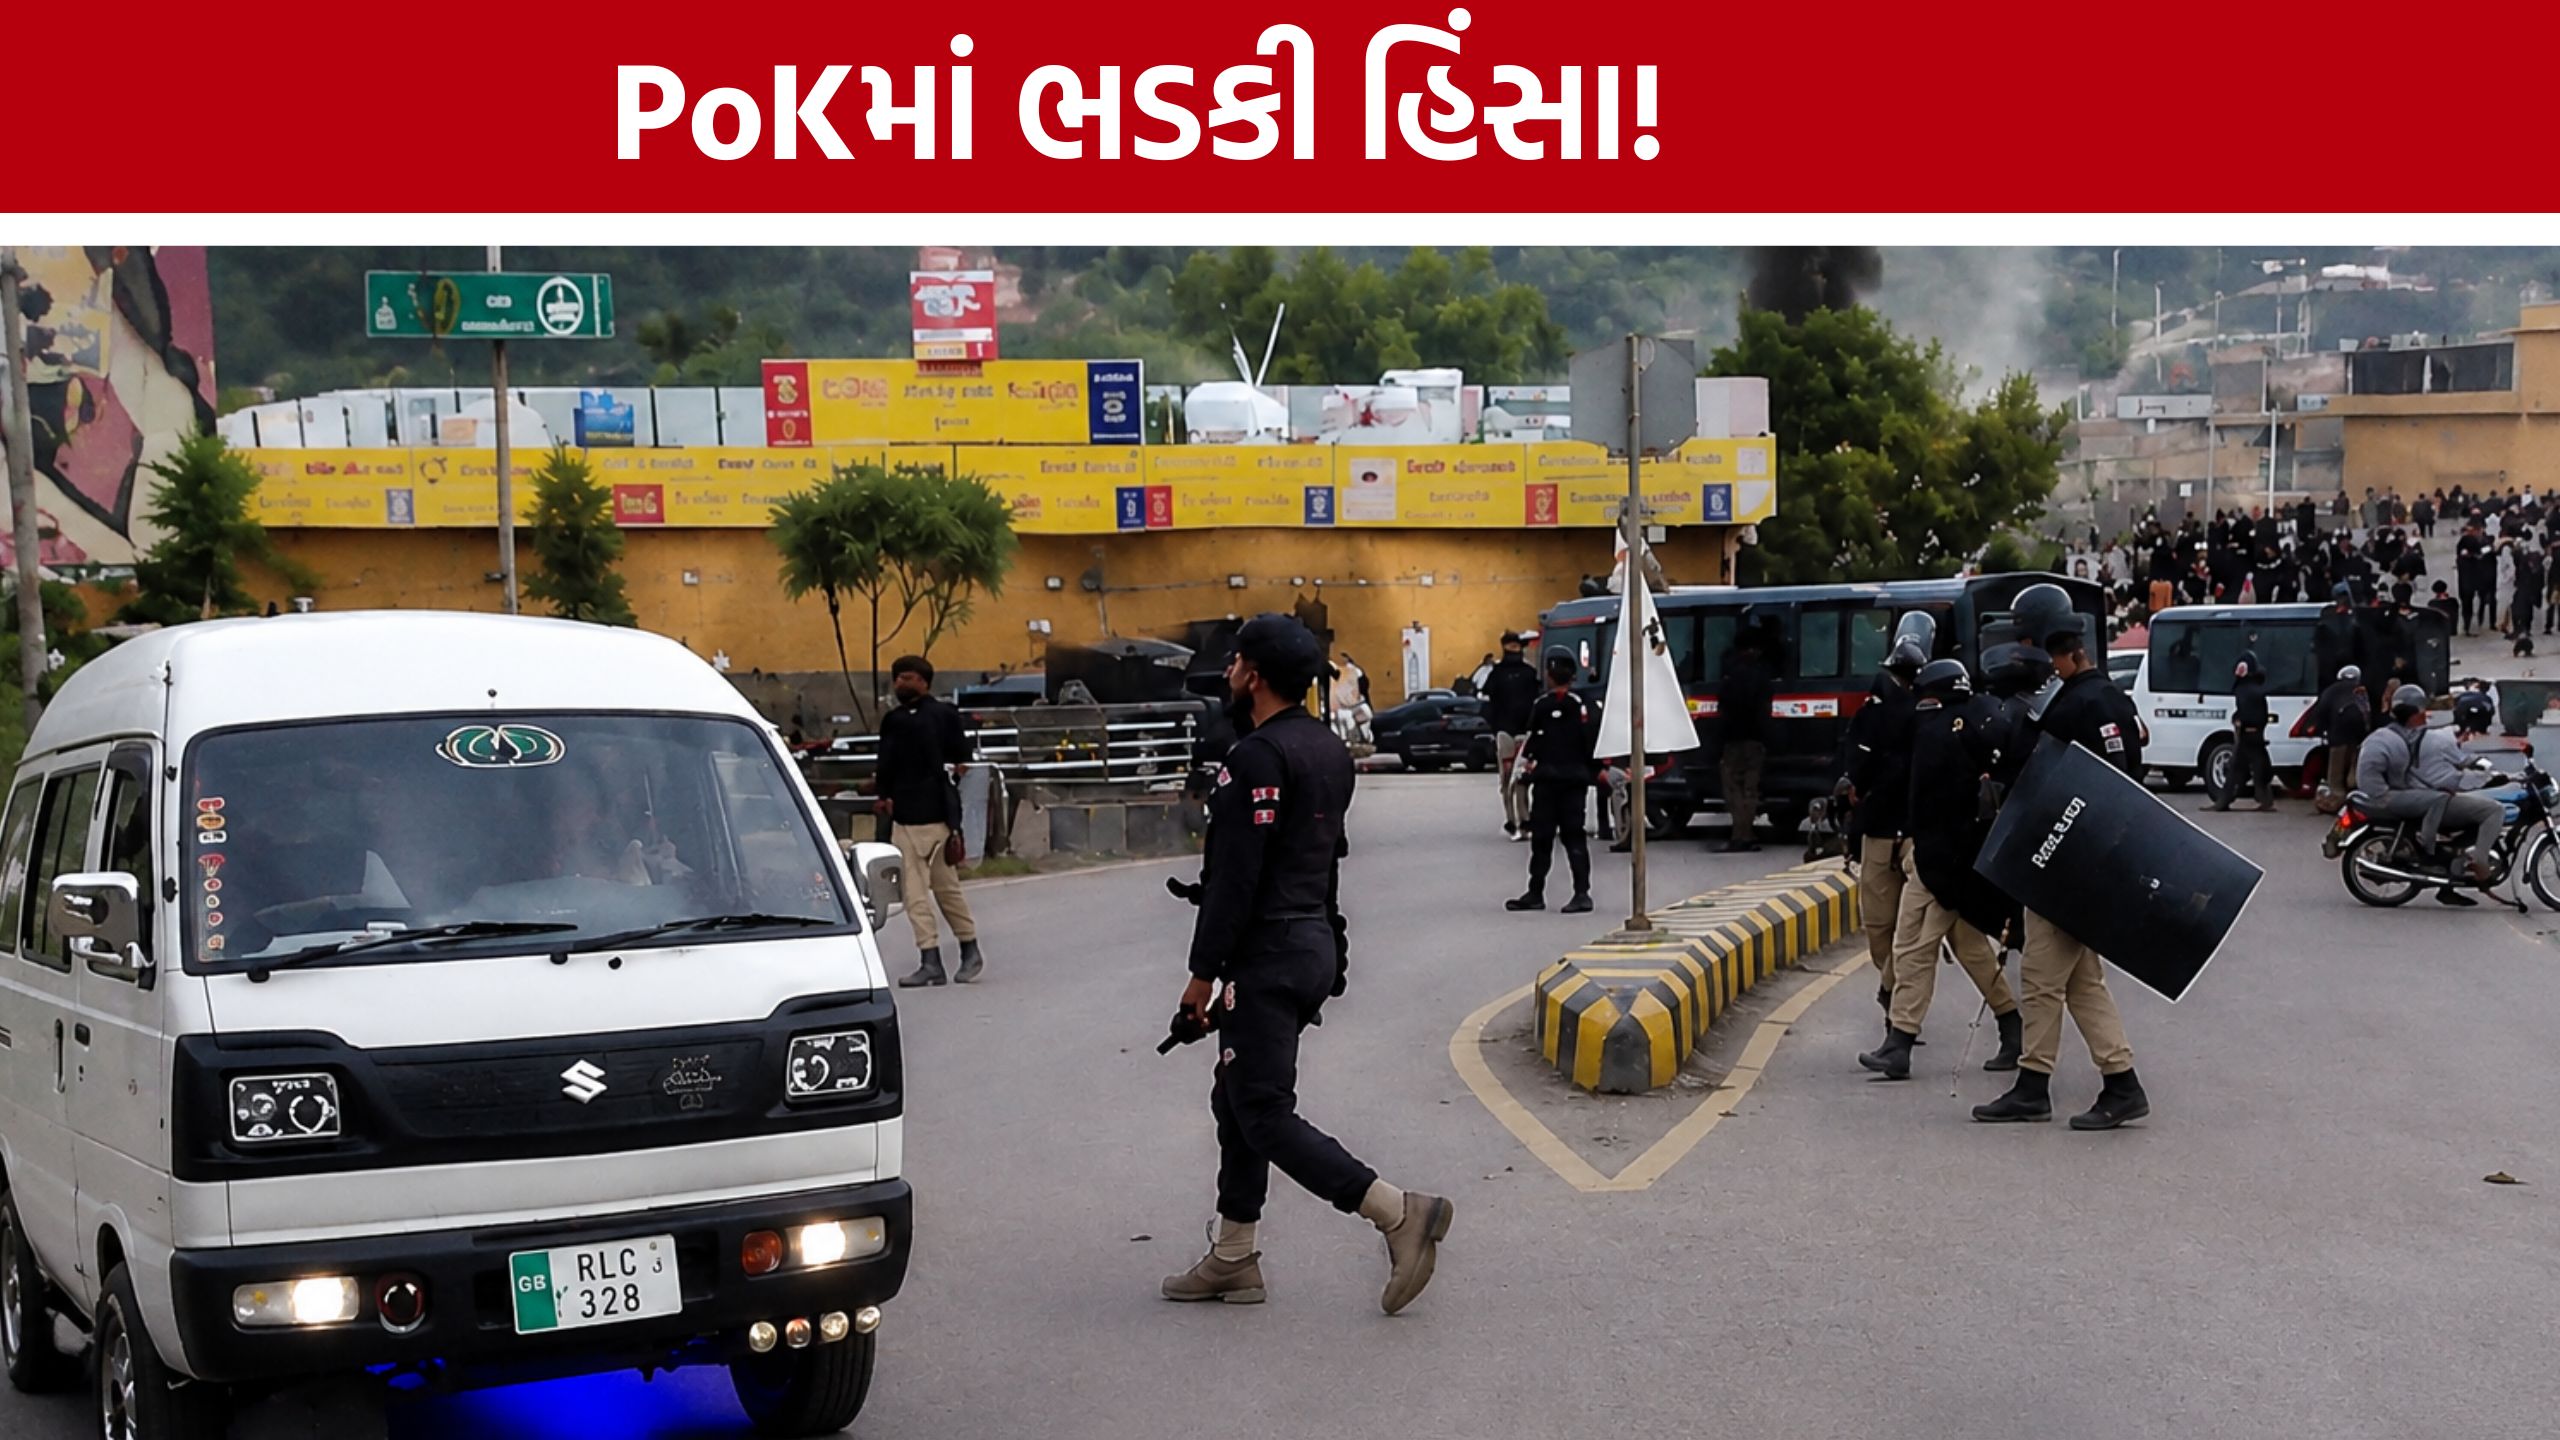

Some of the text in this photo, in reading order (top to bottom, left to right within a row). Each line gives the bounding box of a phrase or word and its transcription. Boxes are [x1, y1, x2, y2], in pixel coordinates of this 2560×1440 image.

[576, 1248, 637, 1282] RLC
[517, 1274, 547, 1292] GB
[579, 1283, 641, 1319] 328
